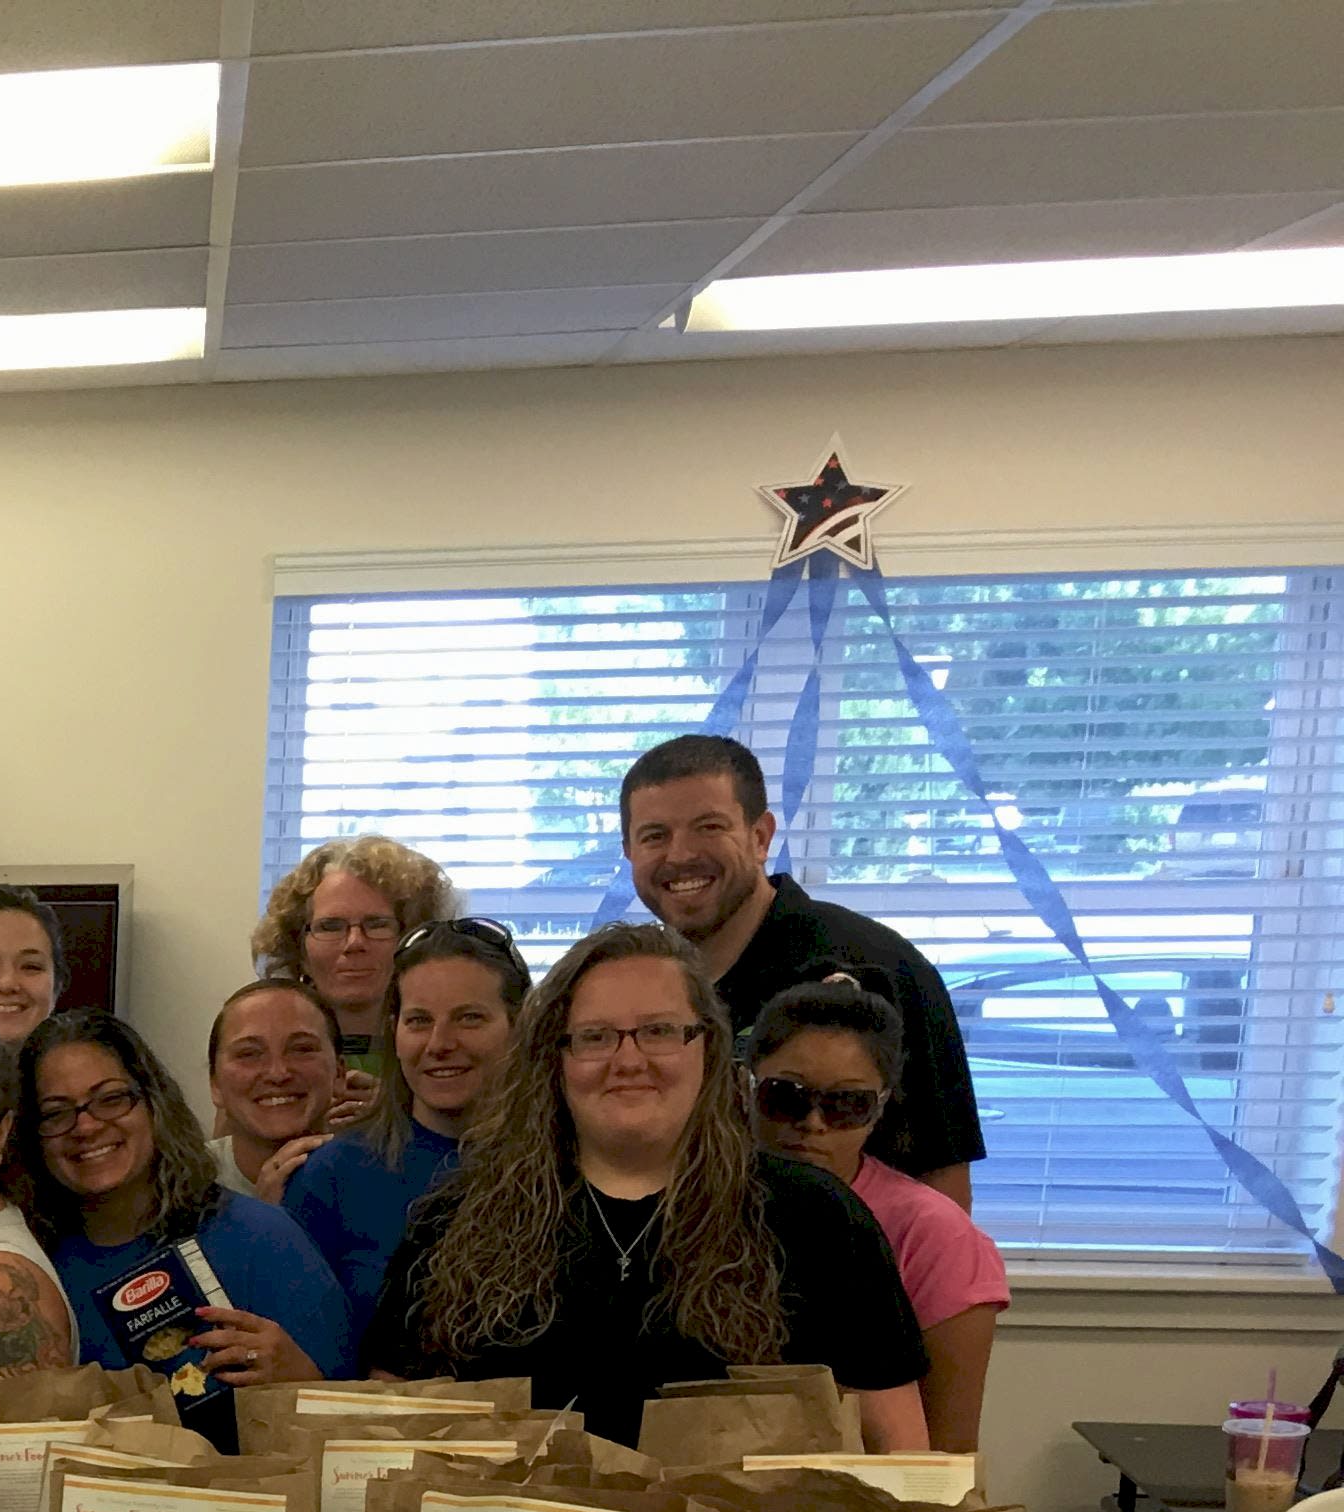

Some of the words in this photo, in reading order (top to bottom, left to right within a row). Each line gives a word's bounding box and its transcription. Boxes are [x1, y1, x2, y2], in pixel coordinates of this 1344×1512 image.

[125, 1274, 165, 1304] Barilla
[126, 1295, 183, 1332] FARFALLE
[25, 1447, 48, 1462] Foo
[332, 1467, 374, 1486] Summer
